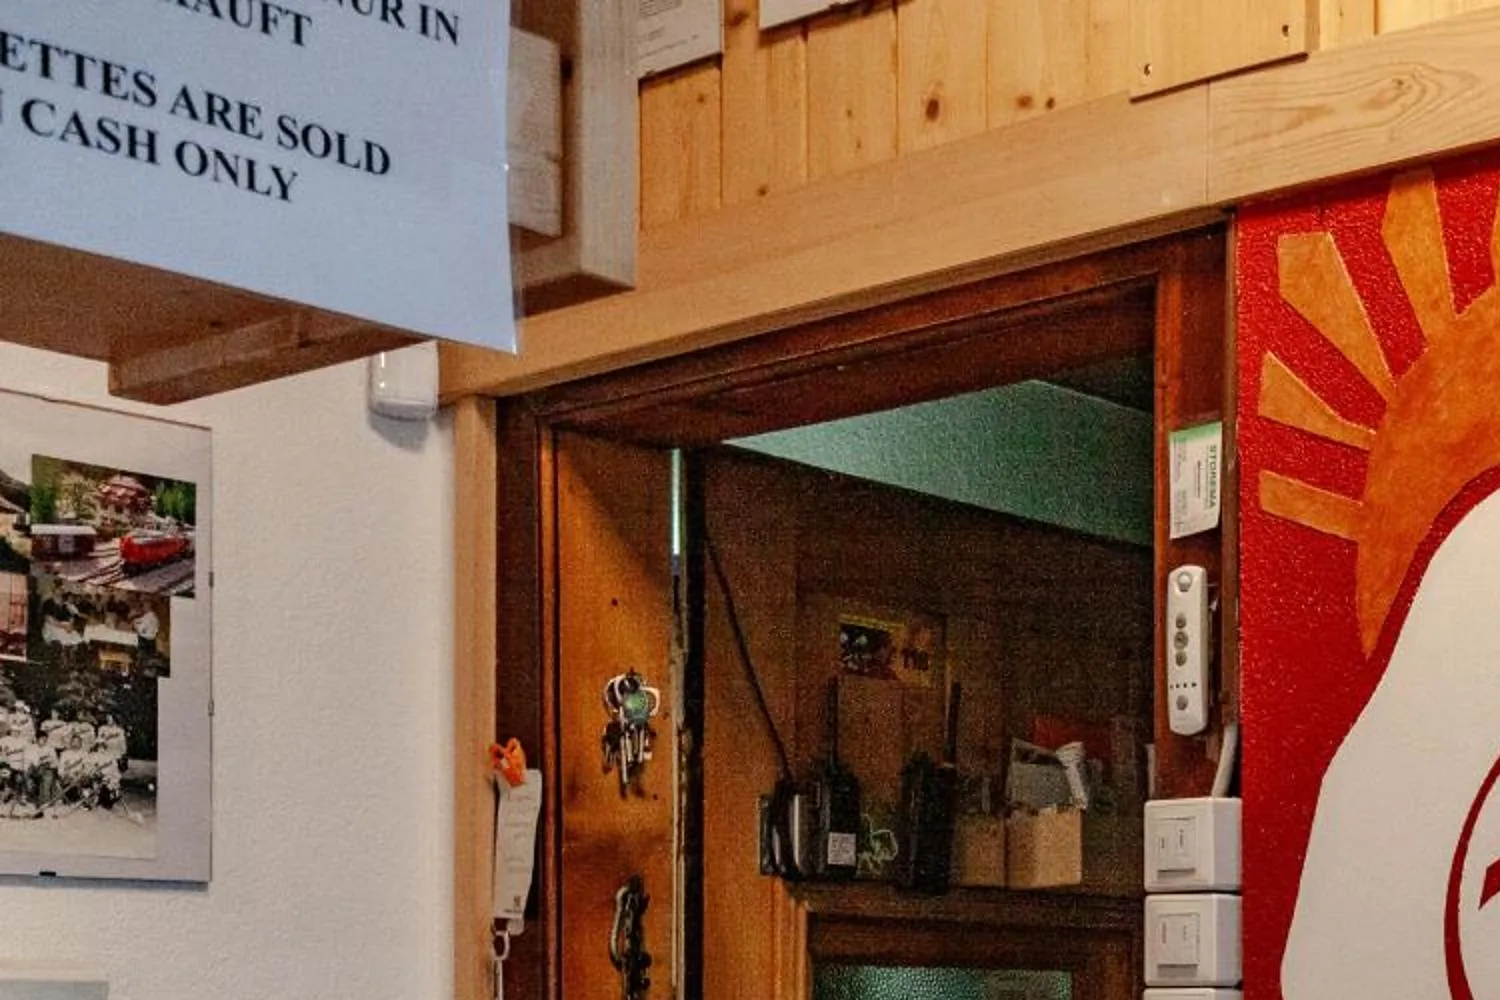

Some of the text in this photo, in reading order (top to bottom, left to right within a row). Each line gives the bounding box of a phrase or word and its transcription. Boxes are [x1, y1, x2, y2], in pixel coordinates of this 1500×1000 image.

[328, 0, 459, 46] UR IN
[0, 31, 157, 107] ETTES
[169, 84, 263, 140] ARE
[277, 115, 391, 176] SOLD
[21, 98, 160, 165] CASH
[175, 140, 298, 203] ONLY
